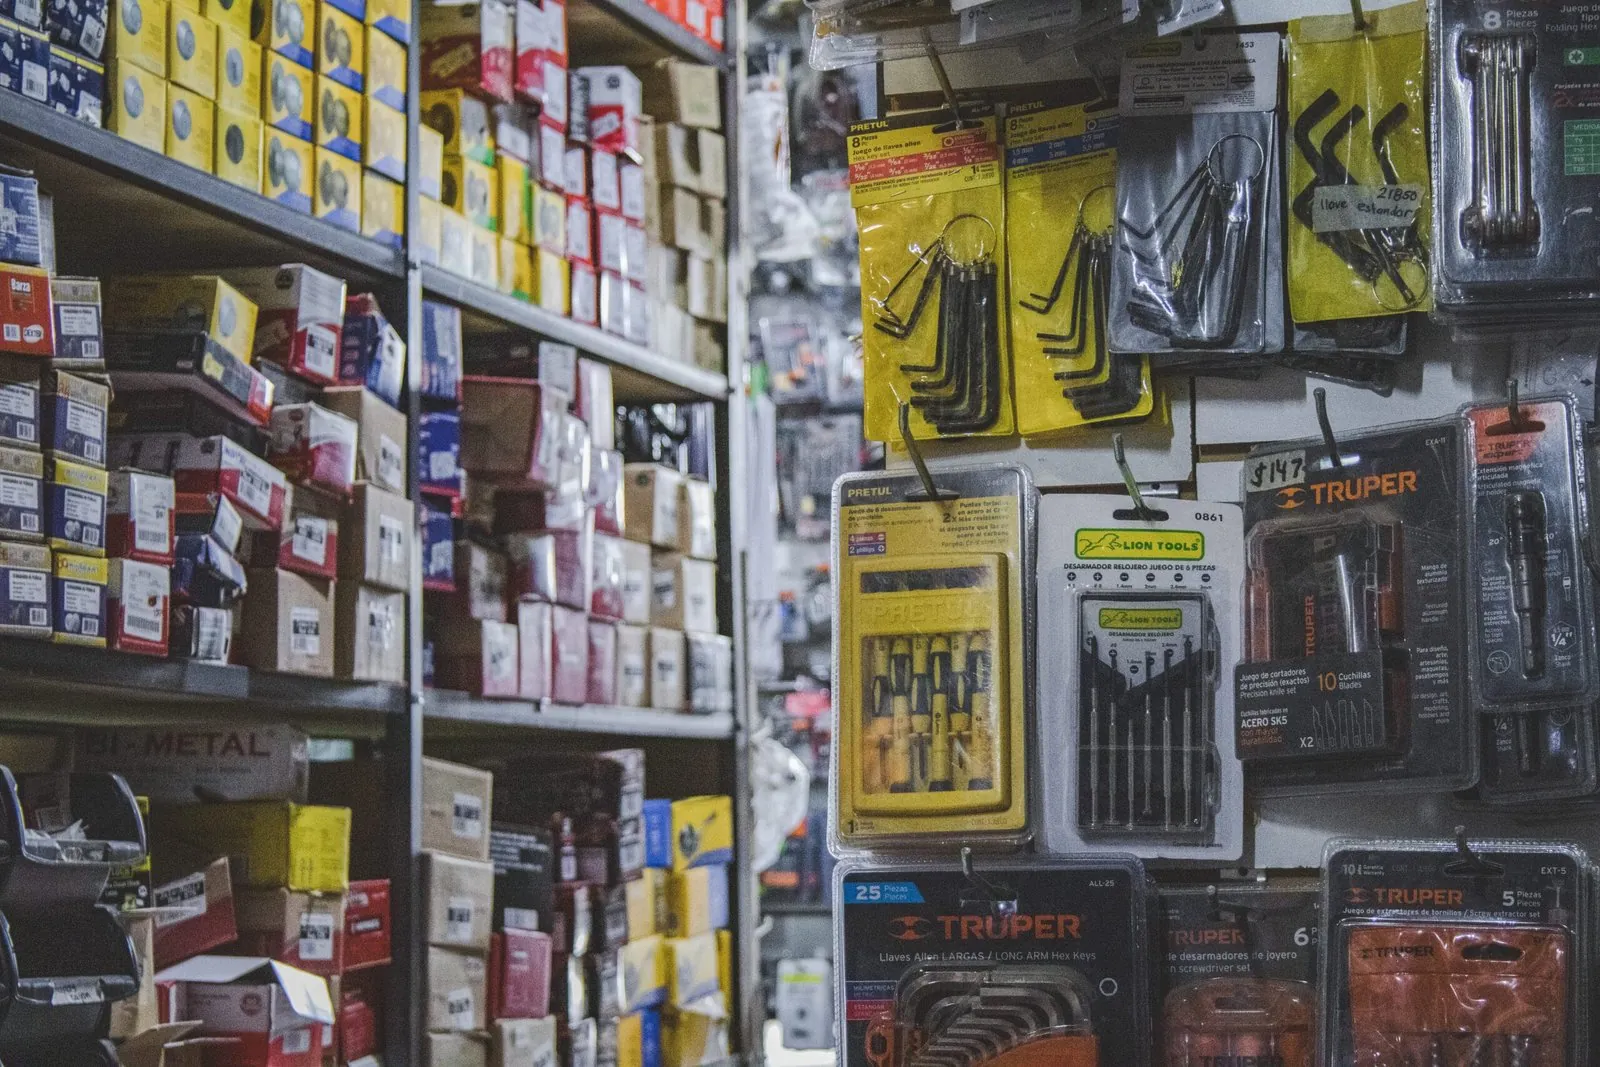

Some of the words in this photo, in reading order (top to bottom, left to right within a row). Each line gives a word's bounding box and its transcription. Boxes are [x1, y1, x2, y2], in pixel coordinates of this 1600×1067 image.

[1560, 4, 1589, 14] Juego
[1483, 10, 1501, 30] 8
[1581, 13, 1600, 22] tipo
[1581, 22, 1598, 31] Hex
[1010, 101, 1045, 114] PRETUL
[850, 121, 889, 132] PRETUL
[1010, 120, 1018, 131] 8
[852, 137, 860, 148] 8
[852, 147, 872, 156] Juego
[1488, 440, 1531, 452] TRUPER
[1250, 458, 1303, 488] $147
[848, 486, 893, 498] PRETUL
[1310, 470, 1419, 506] TRUPER
[1195, 512, 1223, 522] 0861
[1123, 541, 1153, 551] LION
[1157, 541, 1198, 552] TOOLS
[1305, 595, 1315, 656] TRUPER
[1551, 632, 1573, 647] 1/4"
[1240, 672, 1260, 681] Juego
[1271, 668, 1306, 678] cortadores
[1338, 671, 1371, 681] Cuchillas
[1249, 679, 1278, 690] precisión
[1279, 676, 1310, 687] (exactos)
[1318, 671, 1337, 692] 10
[1339, 680, 1362, 690] Blades
[1240, 689, 1269, 699] Precision
[1286, 686, 1297, 695] set
[1241, 718, 1269, 729] ACERO
[1271, 716, 1288, 726] SK5
[149, 731, 271, 757] METAL
[1300, 736, 1314, 748] X2
[1540, 866, 1567, 875] EXT-5
[856, 885, 881, 900] 25
[1374, 888, 1463, 905] TRUPER
[1502, 890, 1515, 907] 5
[937, 914, 1081, 940] TRUPER
[1293, 926, 1310, 947] 6
[879, 952, 911, 962] Llaves
[914, 952, 939, 961] Allen
[941, 952, 984, 961] LARGAS
[995, 952, 1023, 961] LONG
[1052, 951, 1070, 960] Hex
[1073, 951, 1096, 962] Keys
[1180, 951, 1249, 961] desarmadores
[1265, 951, 1298, 962] joyero
[1375, 946, 1434, 958] TRUPER
[1178, 963, 1233, 973] screwdriver
